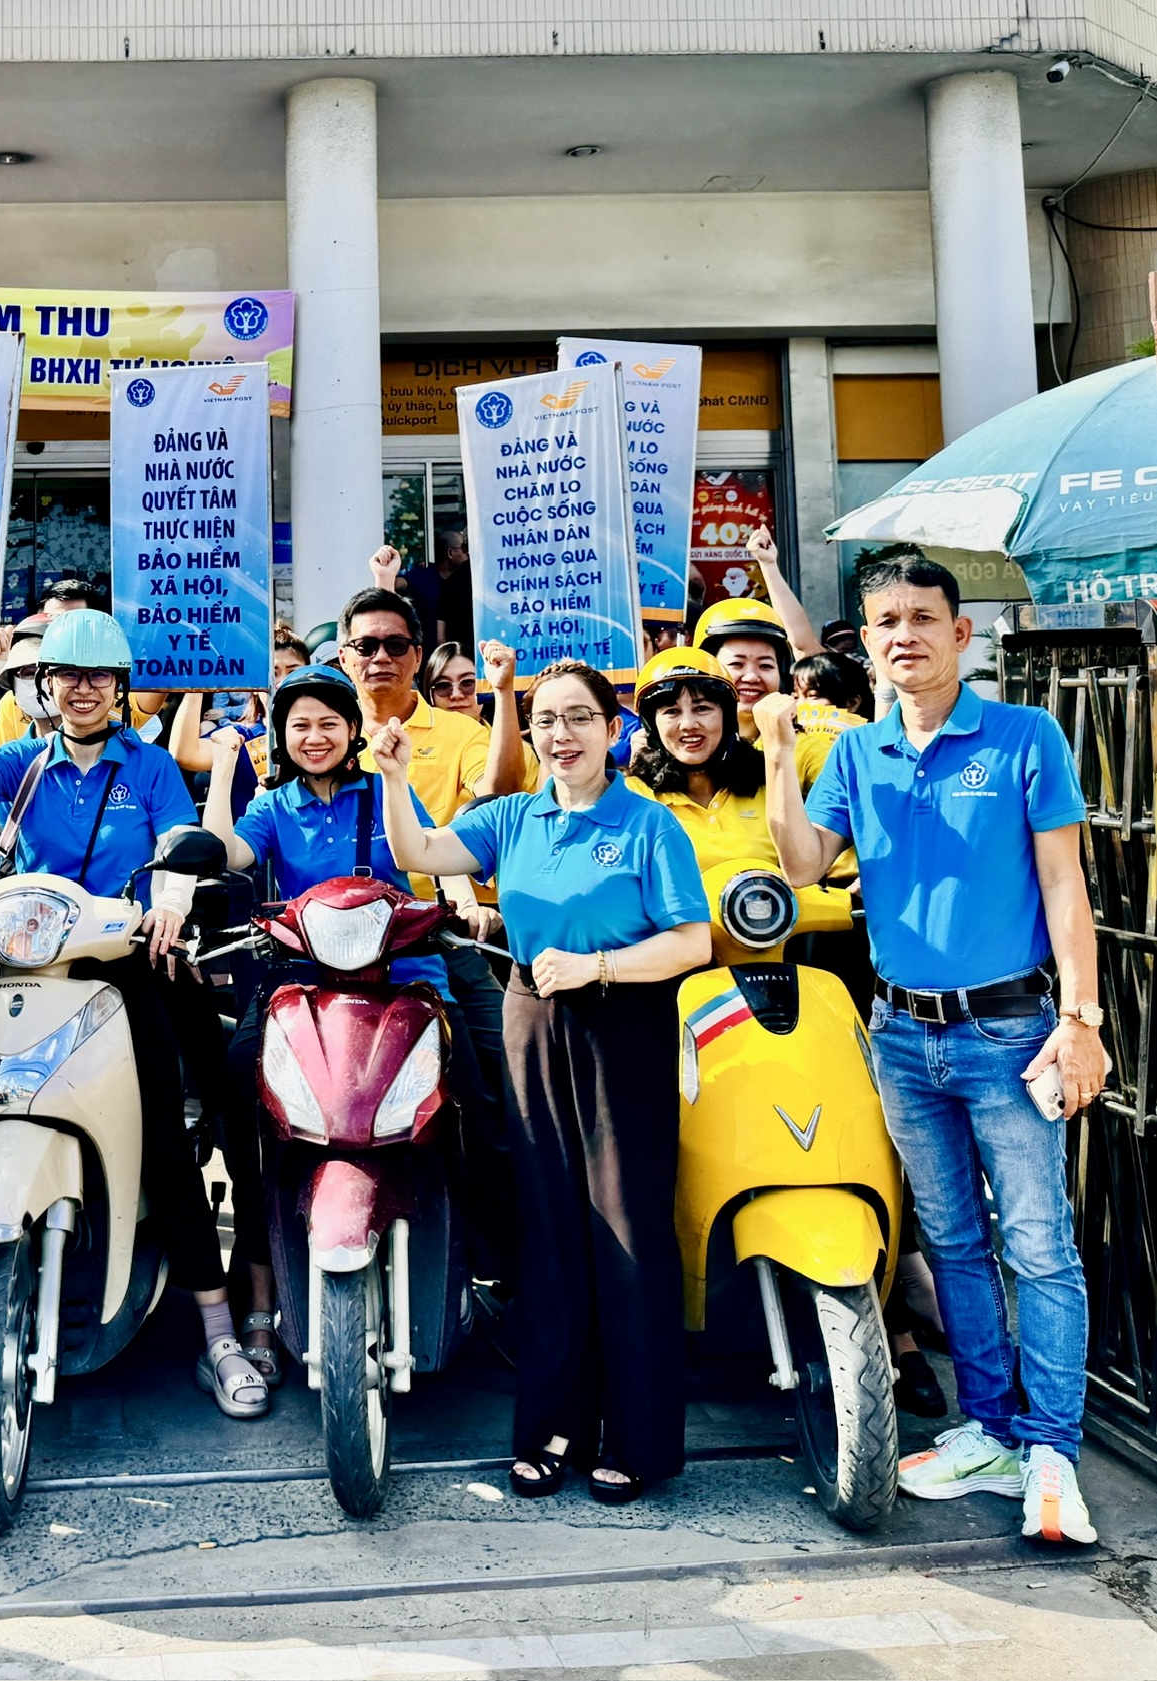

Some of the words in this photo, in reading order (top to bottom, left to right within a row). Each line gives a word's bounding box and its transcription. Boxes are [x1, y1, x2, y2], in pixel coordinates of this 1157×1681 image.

[36, 306, 110, 337] THU
[30, 357, 101, 384] BHXH
[414, 360, 482, 380] DỊCH
[390, 386, 414, 397] bưu
[417, 386, 447, 398] kiện,
[625, 380, 659, 388] VIETNAM
[388, 401, 405, 413] ủy
[406, 401, 436, 412] thác,
[641, 400, 660, 414] VÀ
[728, 395, 769, 406] CMND
[534, 411, 572, 421] VIETNAM
[575, 406, 600, 415] POST
[153, 427, 203, 454] ĐẢNG
[205, 427, 229, 452] VÀ
[500, 436, 549, 457] ĐẢNG
[554, 430, 578, 449] VÀ
[640, 442, 659, 454] LO
[145, 458, 182, 482] NHÀ
[186, 458, 235, 481] NƯỚC
[496, 459, 532, 480] NHÀ
[537, 456, 587, 475] NƯỚC
[504, 480, 555, 501] CHĂM
[560, 480, 581, 494] LO
[1059, 469, 1123, 495] FE
[142, 485, 195, 514] QUYẾT
[199, 486, 237, 510] TÂM
[633, 501, 664, 516] QUA
[1059, 499, 1096, 513] VAY
[493, 506, 543, 528] CUỘC
[547, 500, 596, 519] SỐNG
[143, 519, 189, 545] THỰC
[193, 519, 236, 544] HIỆN
[501, 528, 549, 549] NHÂN
[554, 525, 590, 544] DÂN
[634, 519, 665, 536] ÁCH
[137, 547, 182, 572] BẢO
[187, 545, 241, 569] HIỂM
[497, 551, 556, 571] THÔNG
[562, 548, 598, 566] QUA
[149, 575, 176, 597] XÃ
[184, 575, 228, 601] HỘI,
[496, 573, 550, 594] CHÍNH
[555, 570, 602, 588] SÁCH
[650, 580, 668, 596] TẾ
[1065, 568, 1112, 604] HỖ
[1117, 573, 1157, 598] TR
[137, 603, 182, 625] BẢO
[187, 601, 241, 625] HIỂM
[510, 595, 545, 615] BẢO
[551, 589, 591, 612] HIỂM
[168, 634, 182, 651] Y
[185, 627, 211, 651] TẾ
[519, 619, 543, 638] XÃ
[548, 616, 585, 637] HỘI,
[534, 637, 573, 661] HIỂM
[579, 643, 589, 657] Y
[592, 636, 612, 656] TẾ
[134, 655, 194, 677] TOÀN
[198, 654, 245, 677] DÂN
[744, 974, 790, 983] VINFAST
